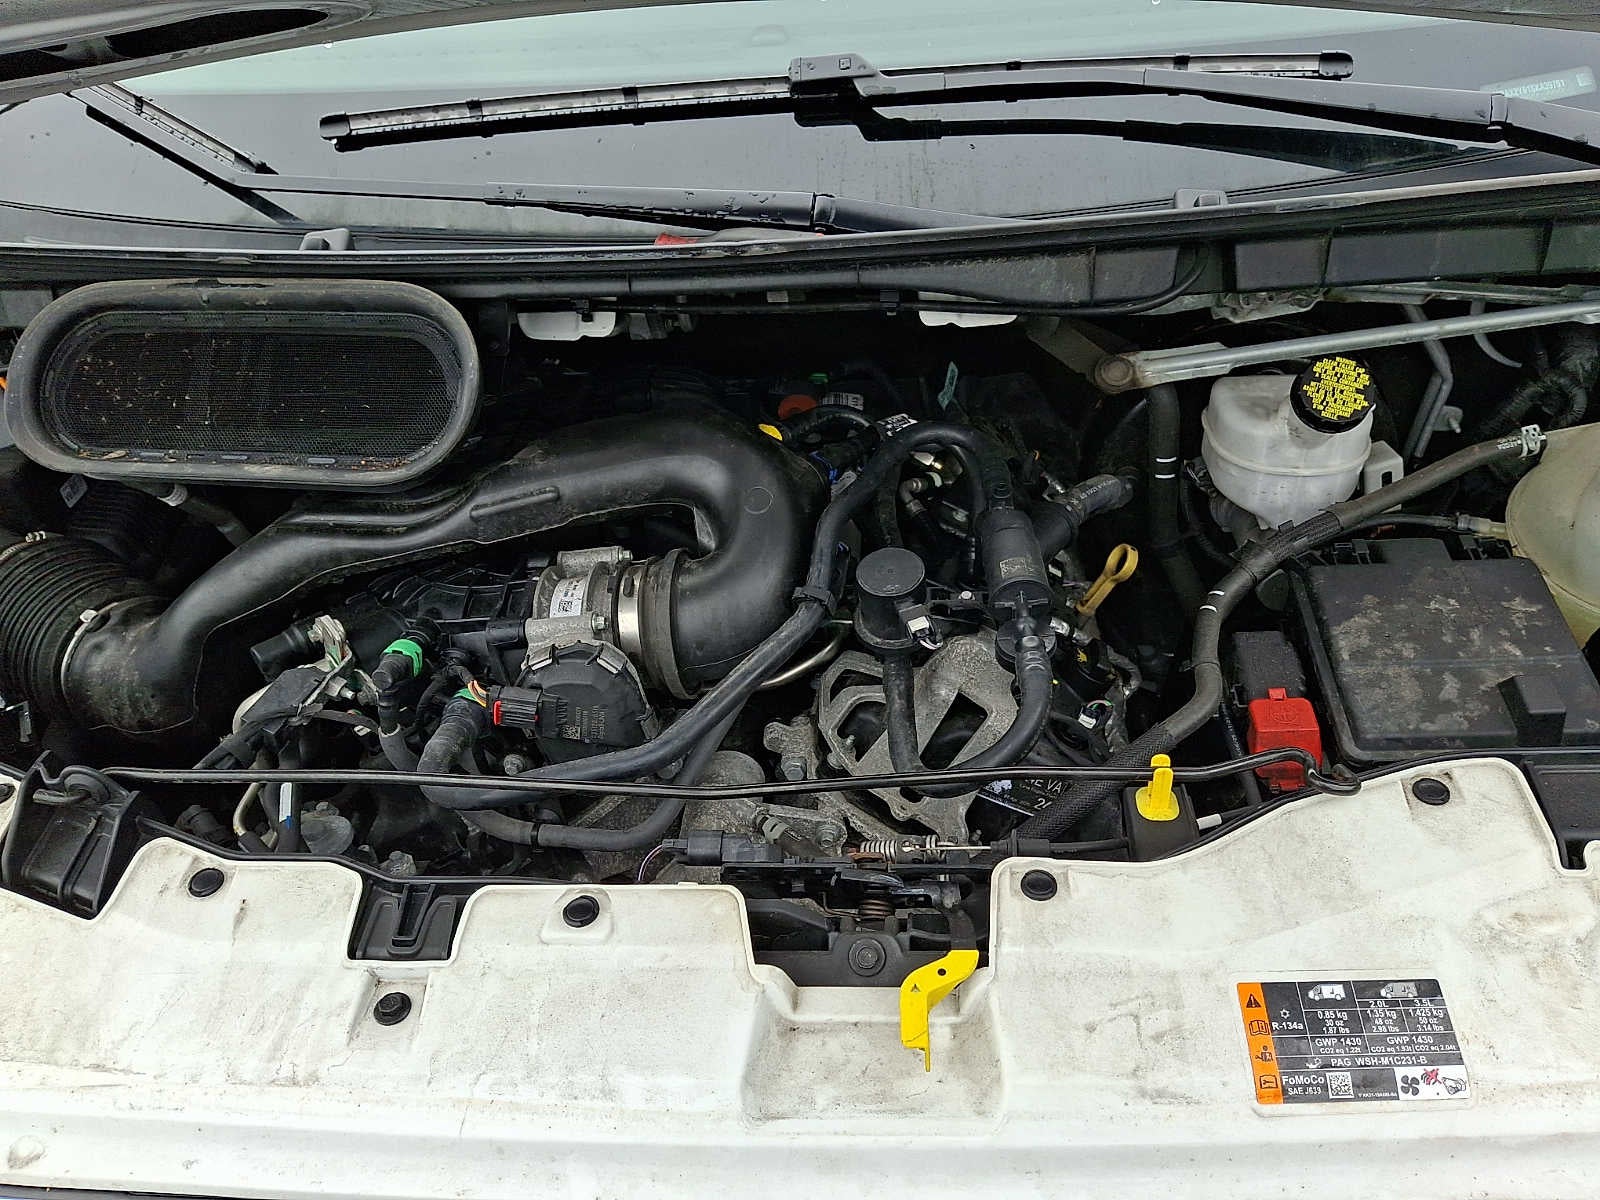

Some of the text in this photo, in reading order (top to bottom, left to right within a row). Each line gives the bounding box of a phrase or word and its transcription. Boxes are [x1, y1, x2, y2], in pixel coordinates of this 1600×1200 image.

[1369, 1000, 1389, 1008] 2.0L
[1414, 999, 1434, 1007] 3.5L
[1318, 1010, 1348, 1020] 0.85 kg
[1367, 1009, 1397, 1019] 1.35 kg
[1409, 1008, 1443, 1018] 1.425 kg
[1272, 1022, 1303, 1031] R-134a
[1315, 1037, 1362, 1047] GWP 1430
[1387, 1036, 1410, 1044] GWP
[1331, 1057, 1428, 1067] PAG WSH-M1C231-B
[1282, 1076, 1324, 1085] FoMoCo
[1288, 1087, 1322, 1095] SAE J639
